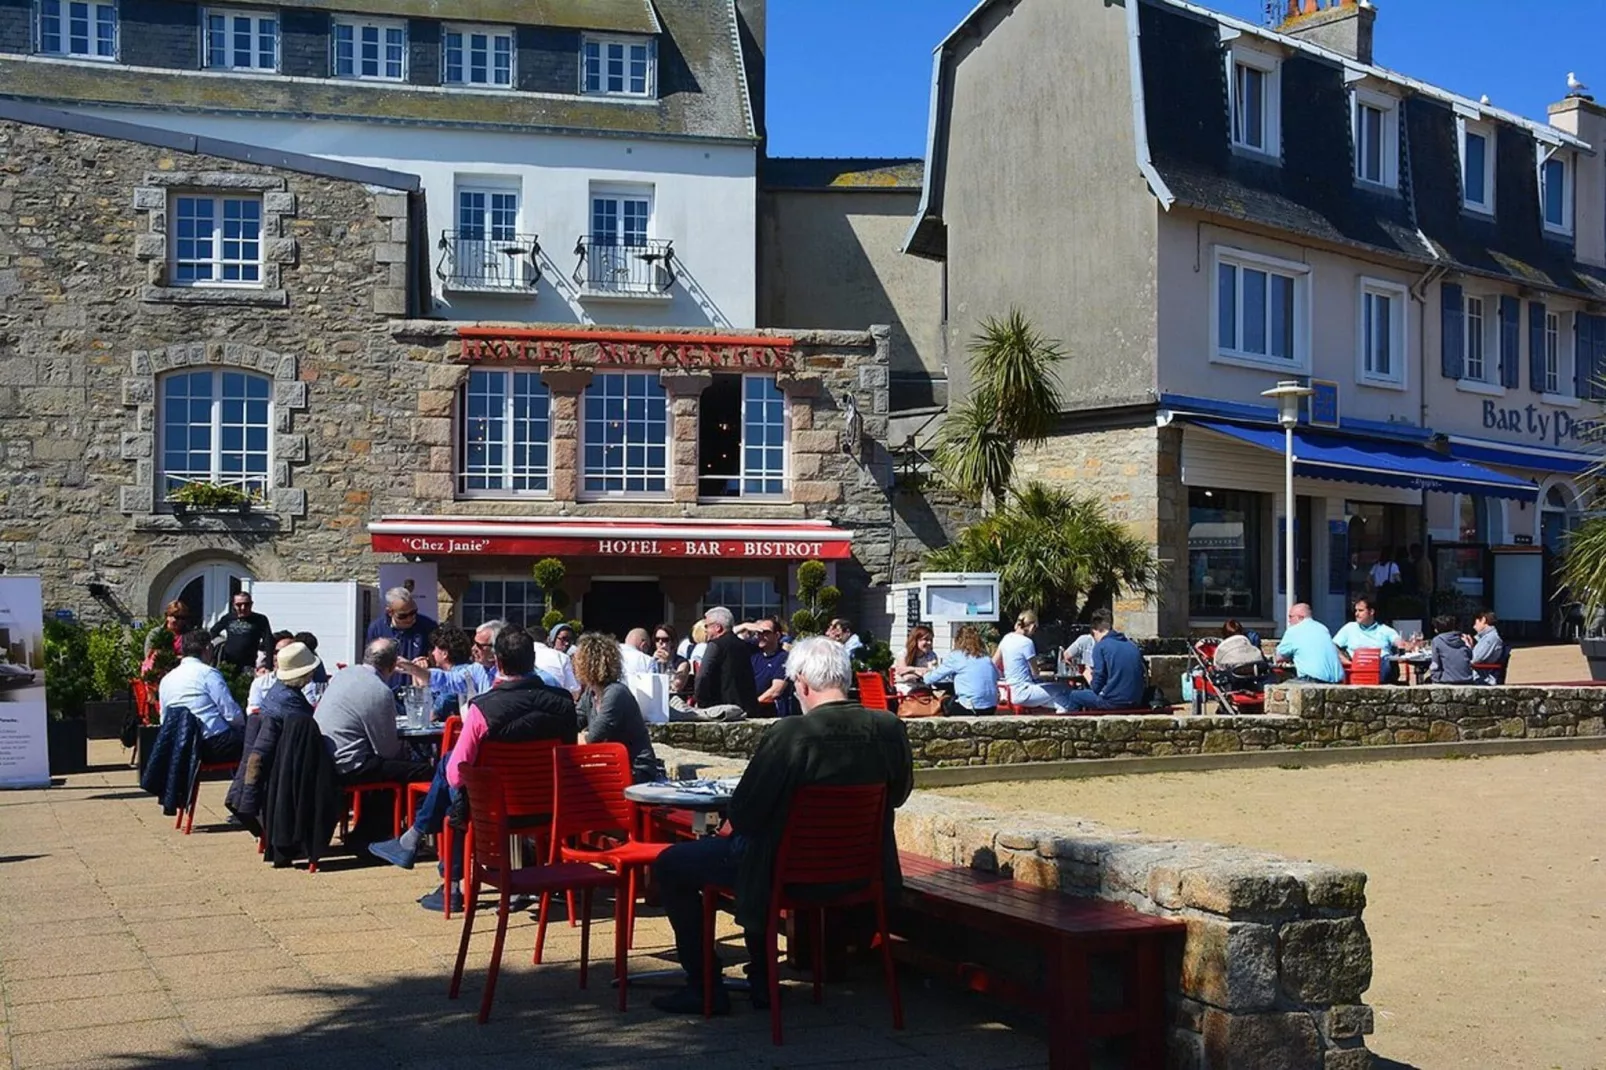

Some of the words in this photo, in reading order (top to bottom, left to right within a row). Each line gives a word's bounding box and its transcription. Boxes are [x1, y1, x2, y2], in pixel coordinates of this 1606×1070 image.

[460, 338, 577, 362] HOTEL
[599, 540, 662, 554] HOTEL
[685, 541, 721, 556] BAR
[744, 542, 823, 557] BISTROT
